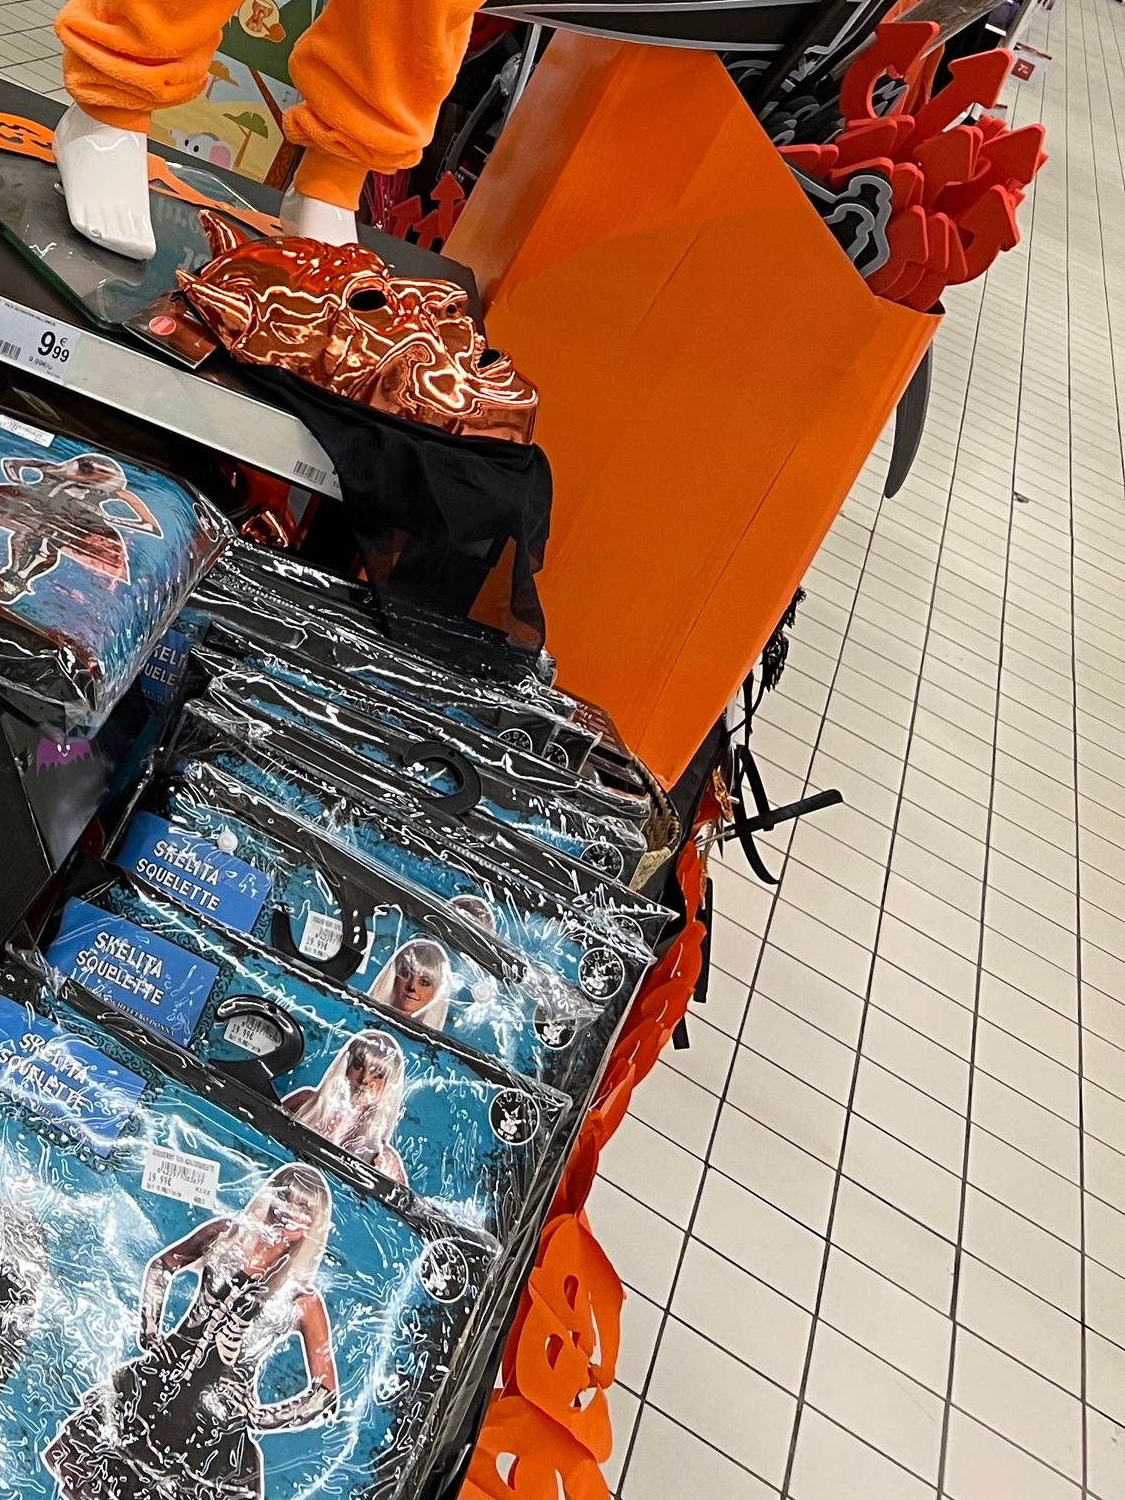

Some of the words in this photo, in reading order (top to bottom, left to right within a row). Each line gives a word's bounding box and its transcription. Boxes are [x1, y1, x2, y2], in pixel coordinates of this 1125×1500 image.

[136, 858, 221, 911] SQUELETTE
[76, 950, 165, 1005] SQUELETTE
[94, 931, 163, 979] SKELITA
